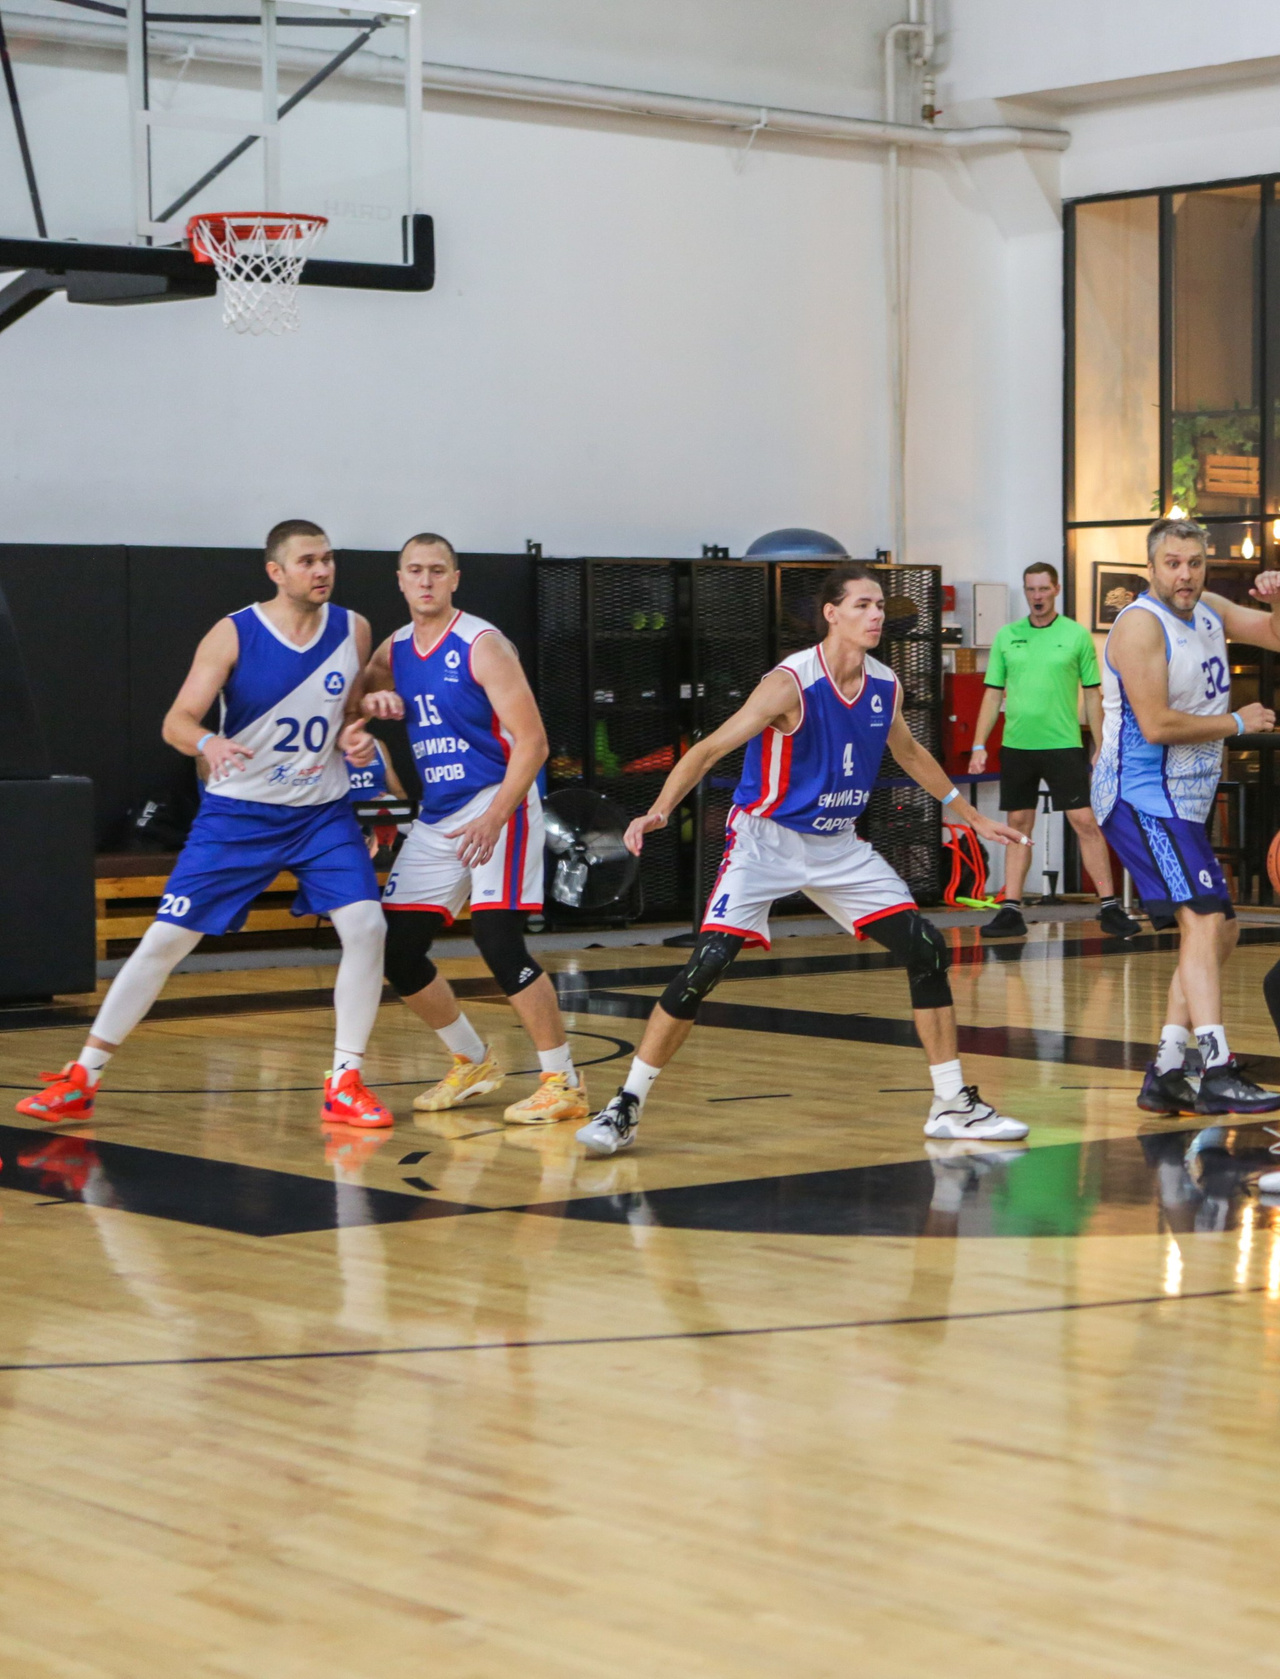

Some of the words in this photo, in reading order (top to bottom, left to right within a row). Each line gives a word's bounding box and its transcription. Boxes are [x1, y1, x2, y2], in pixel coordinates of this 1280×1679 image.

[1201, 656, 1230, 700] 32
[413, 694, 443, 727] 15
[273, 715, 329, 753] 20
[842, 743, 854, 777] 4
[384, 872, 399, 897] 5
[157, 893, 191, 917] 20
[711, 893, 730, 919] 4
